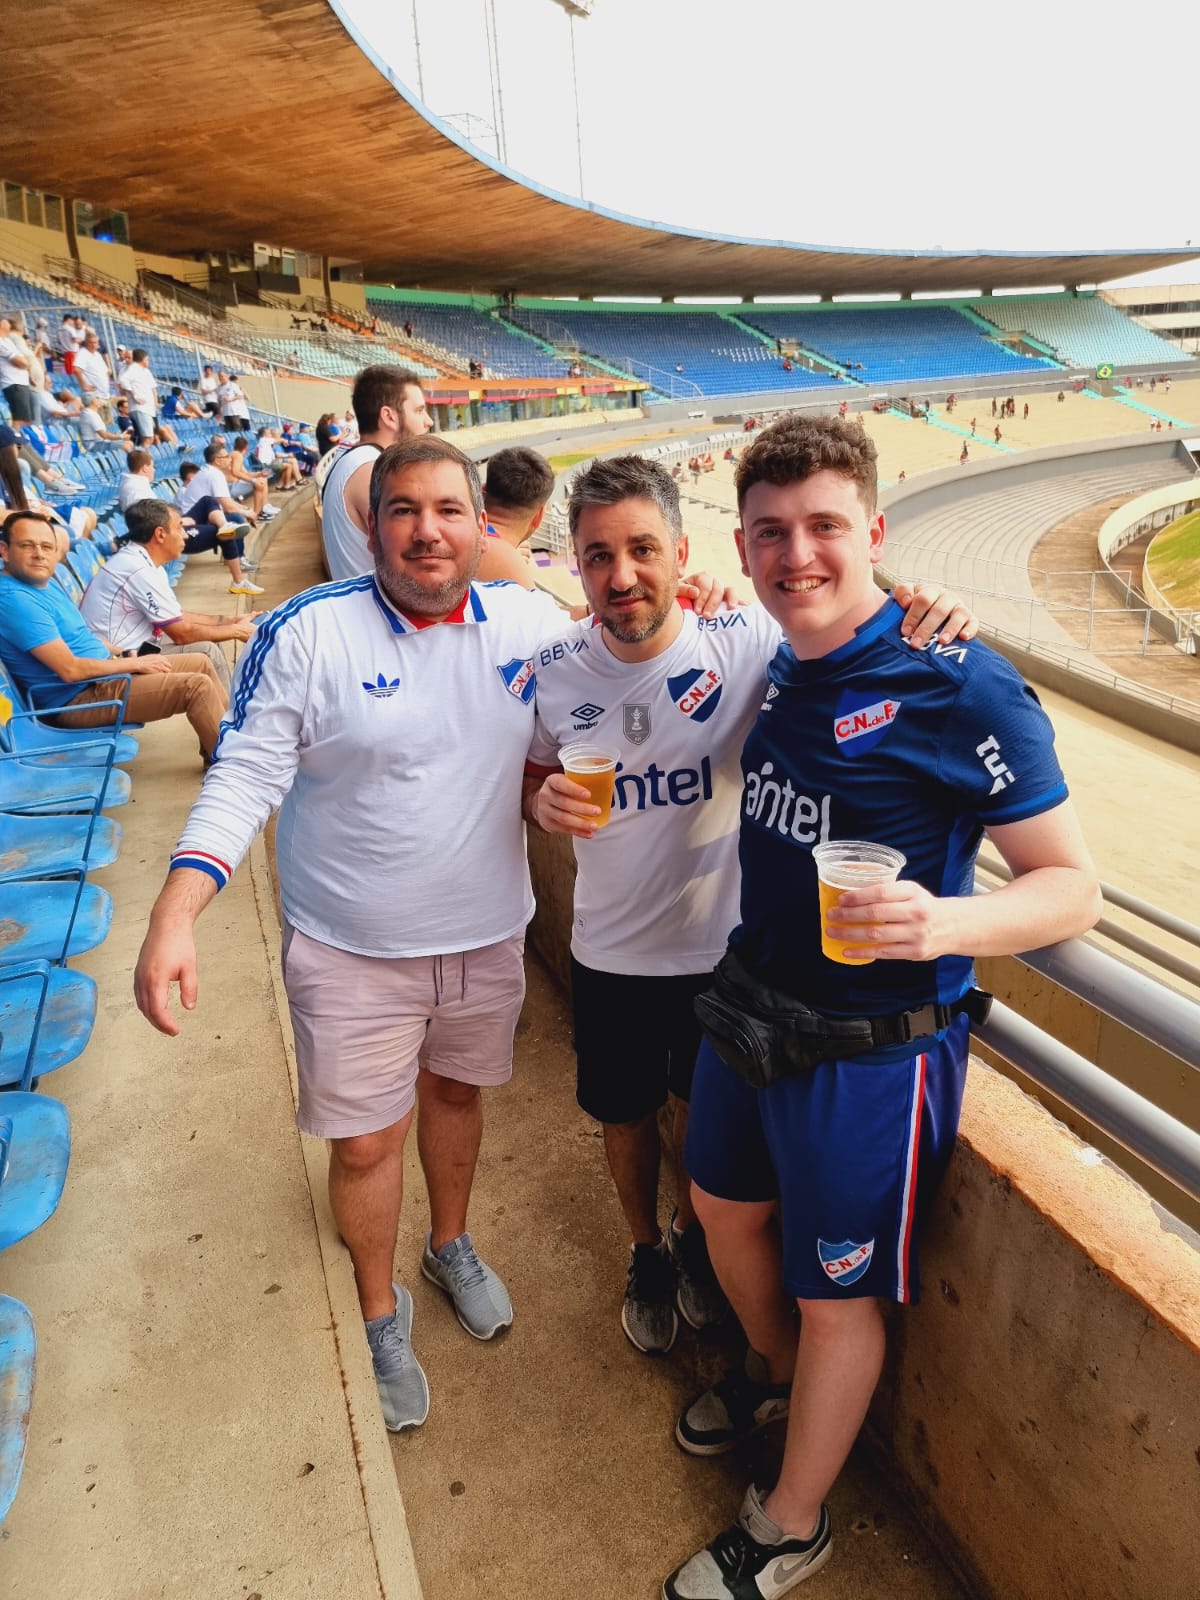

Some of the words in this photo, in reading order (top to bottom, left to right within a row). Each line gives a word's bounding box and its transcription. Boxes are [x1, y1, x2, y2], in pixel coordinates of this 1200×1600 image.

[697, 612, 747, 632] BBVA
[540, 639, 589, 667] BBVA
[902, 633, 968, 664] BVA
[611, 756, 713, 810] ntel
